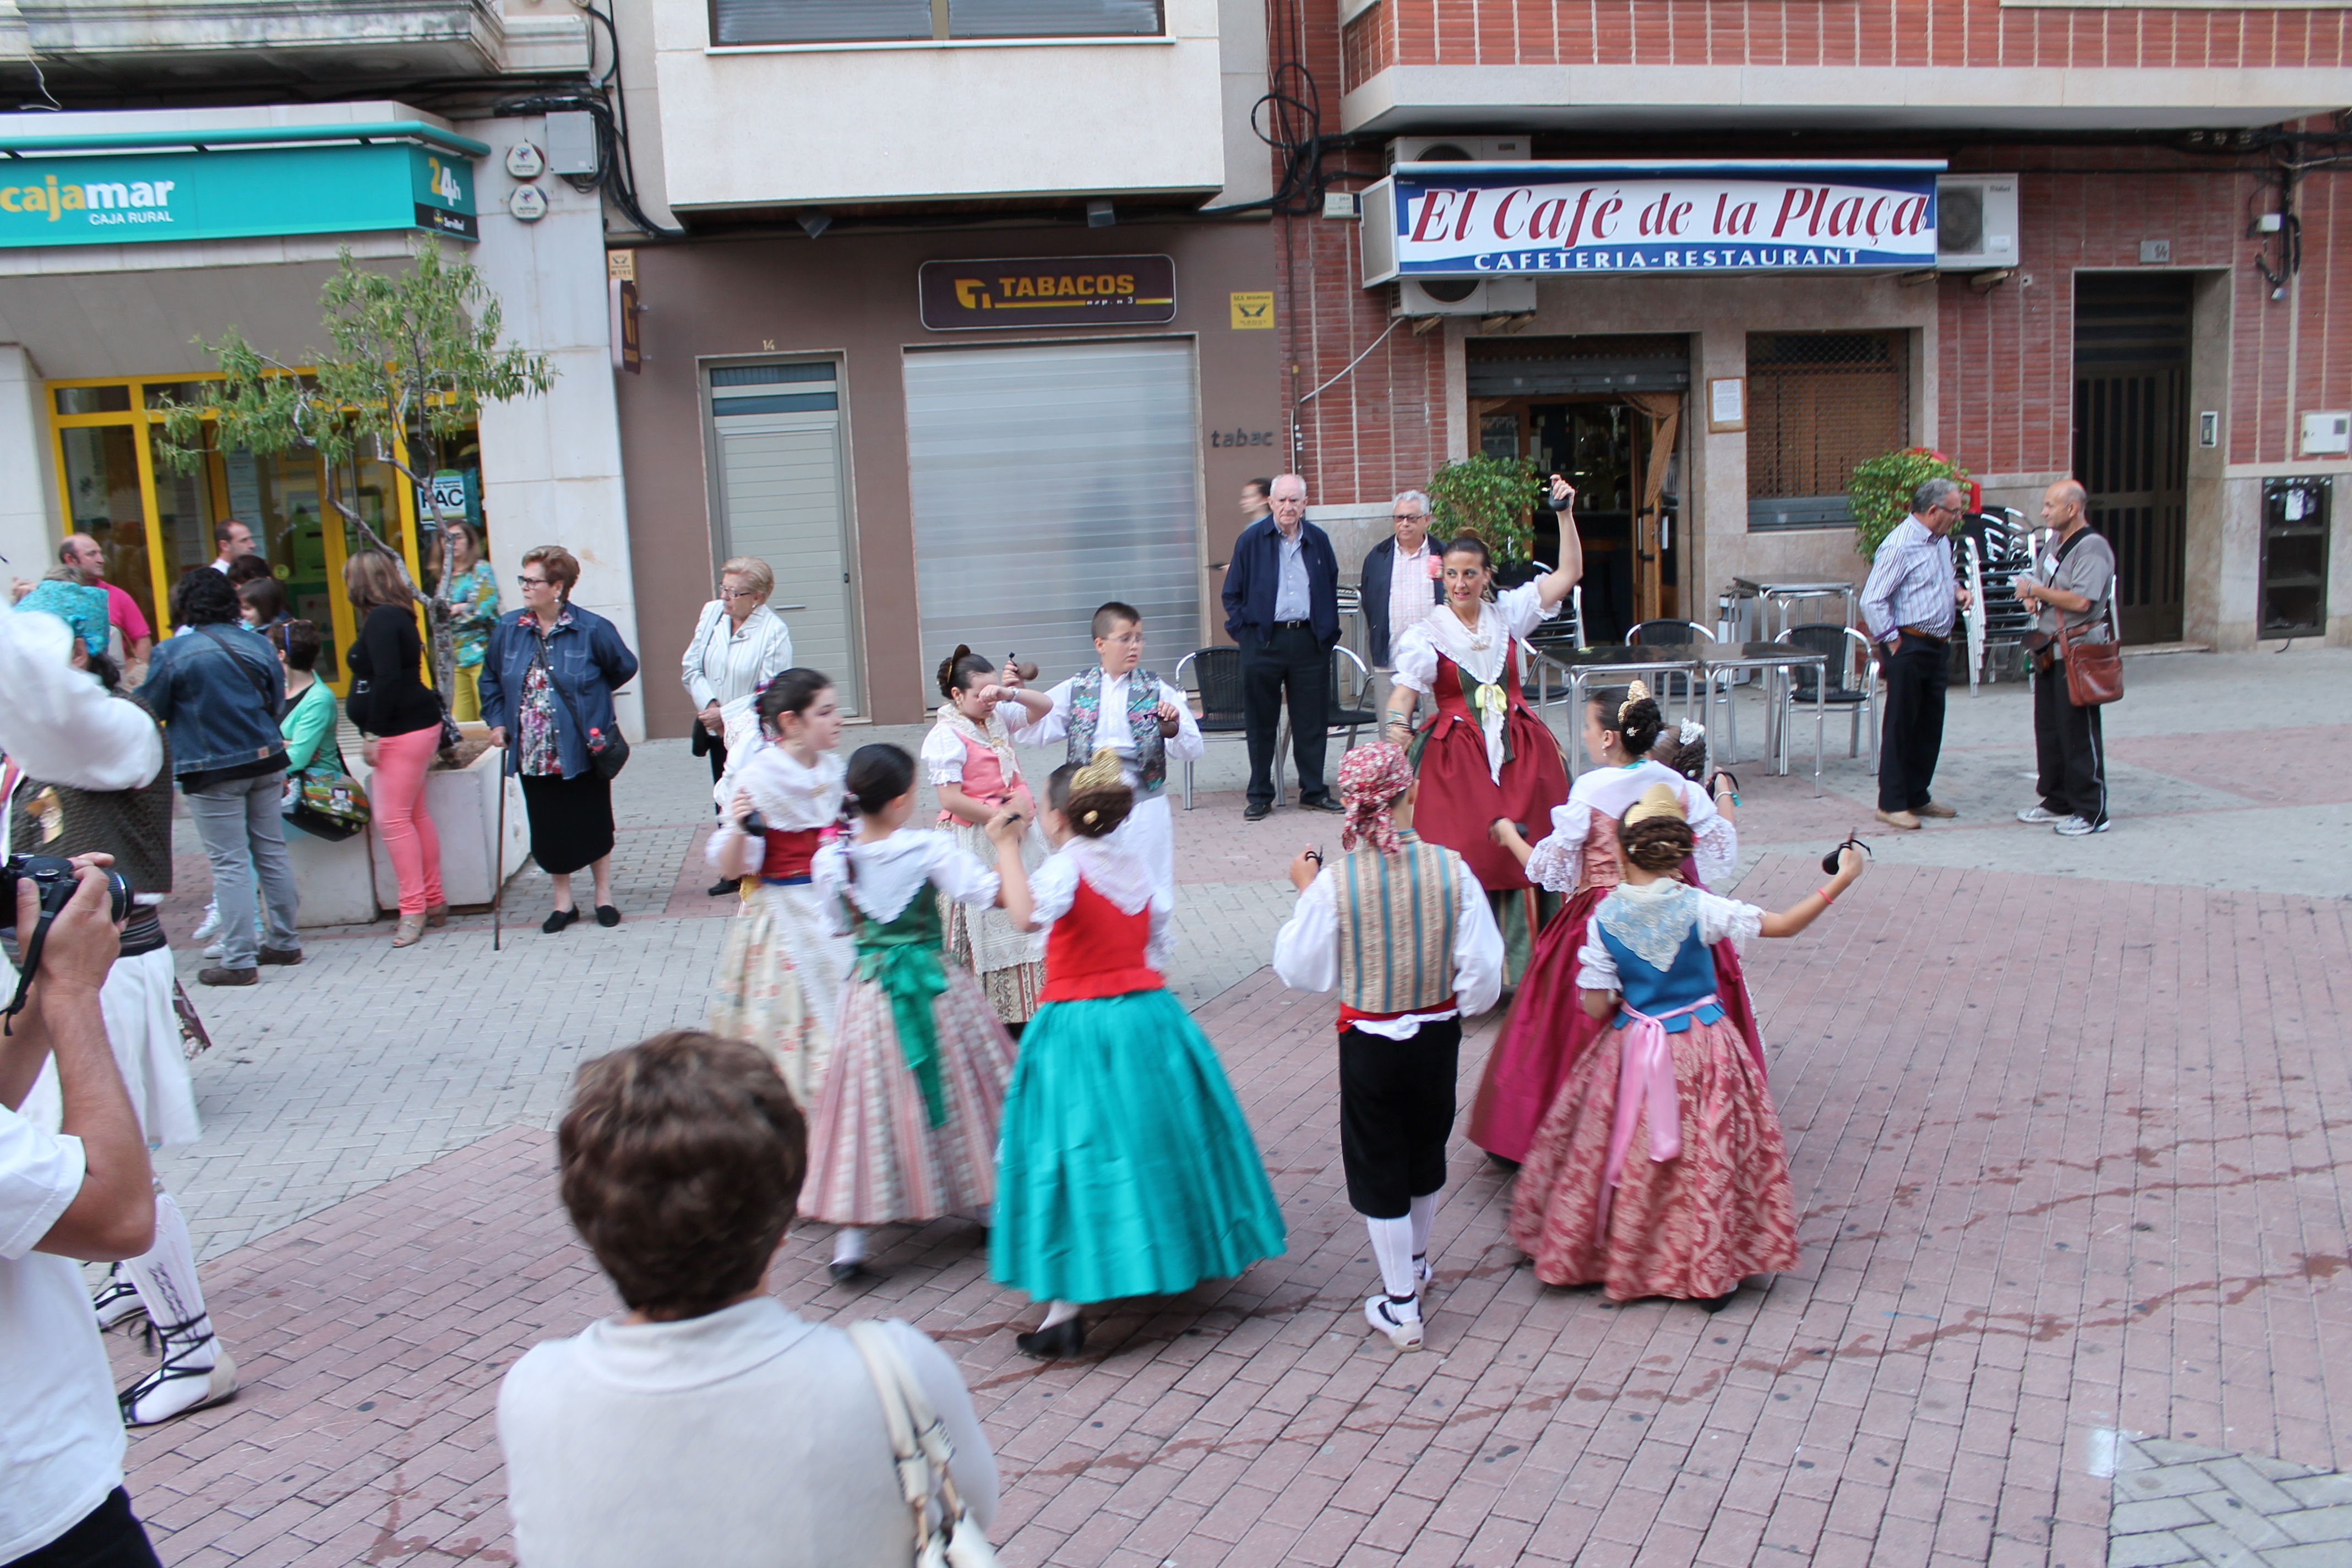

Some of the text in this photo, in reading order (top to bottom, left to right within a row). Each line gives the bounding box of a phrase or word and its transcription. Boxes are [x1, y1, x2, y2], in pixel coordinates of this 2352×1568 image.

[0, 175, 175, 221] cajamar
[89, 211, 174, 225] CAJA RURAL
[1410, 187, 1930, 249] El Café de la Plaça
[1473, 248, 1860, 270] CAFETERIA-RESTAURANT
[999, 275, 1134, 297] TABACOS
[1211, 427, 1273, 447] tabac
